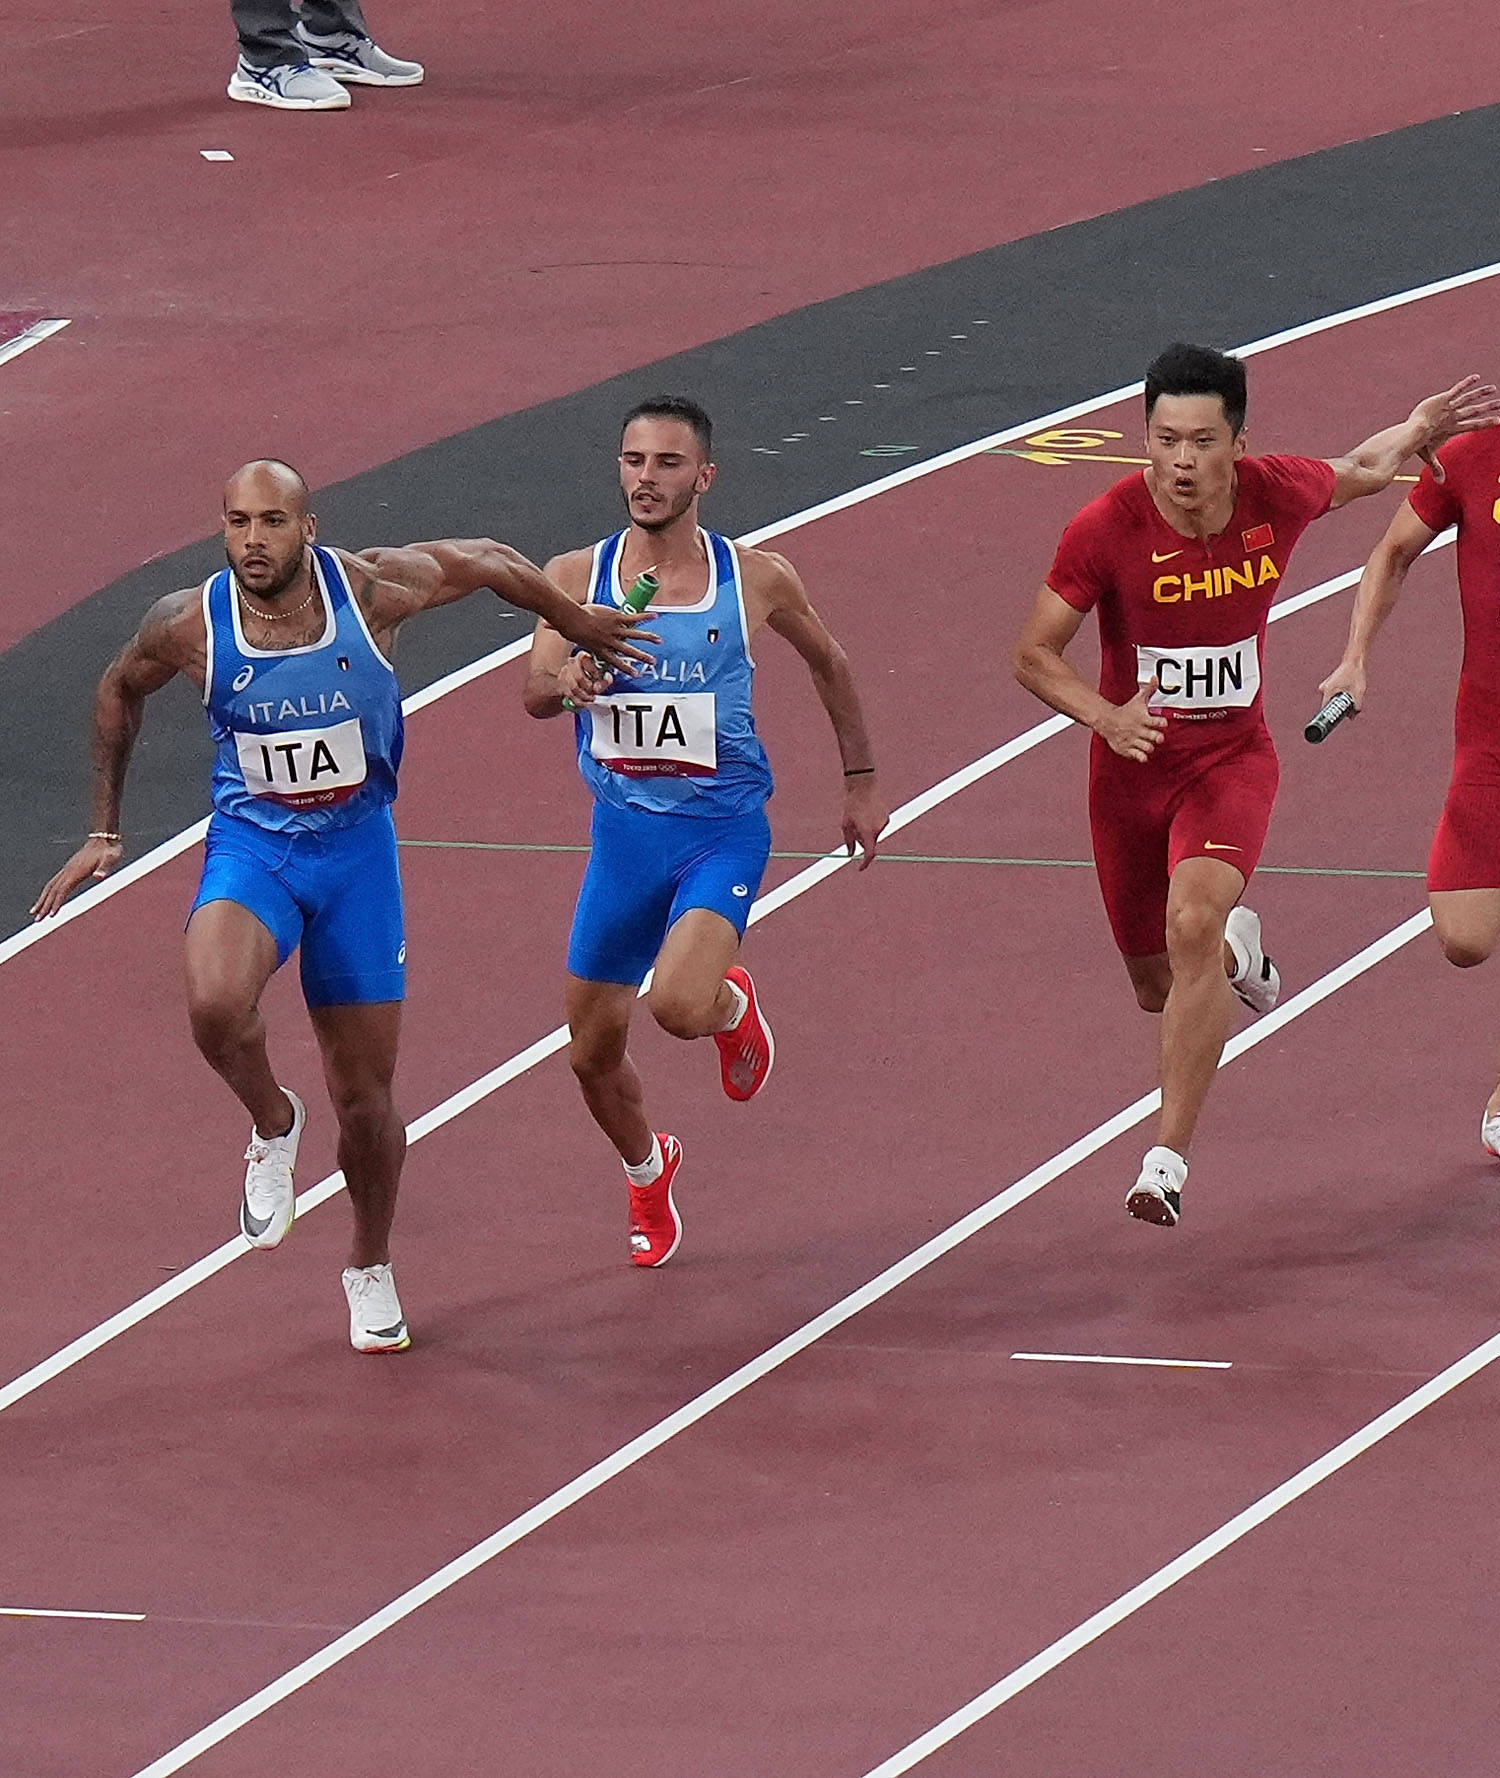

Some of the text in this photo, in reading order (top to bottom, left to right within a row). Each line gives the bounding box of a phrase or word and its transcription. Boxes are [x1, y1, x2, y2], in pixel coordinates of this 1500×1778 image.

[1153, 554, 1281, 603] CHINA
[1156, 651, 1243, 698] CHN
[248, 690, 351, 724] ITALIA
[611, 704, 687, 748] ITA
[260, 739, 340, 784] ITA
